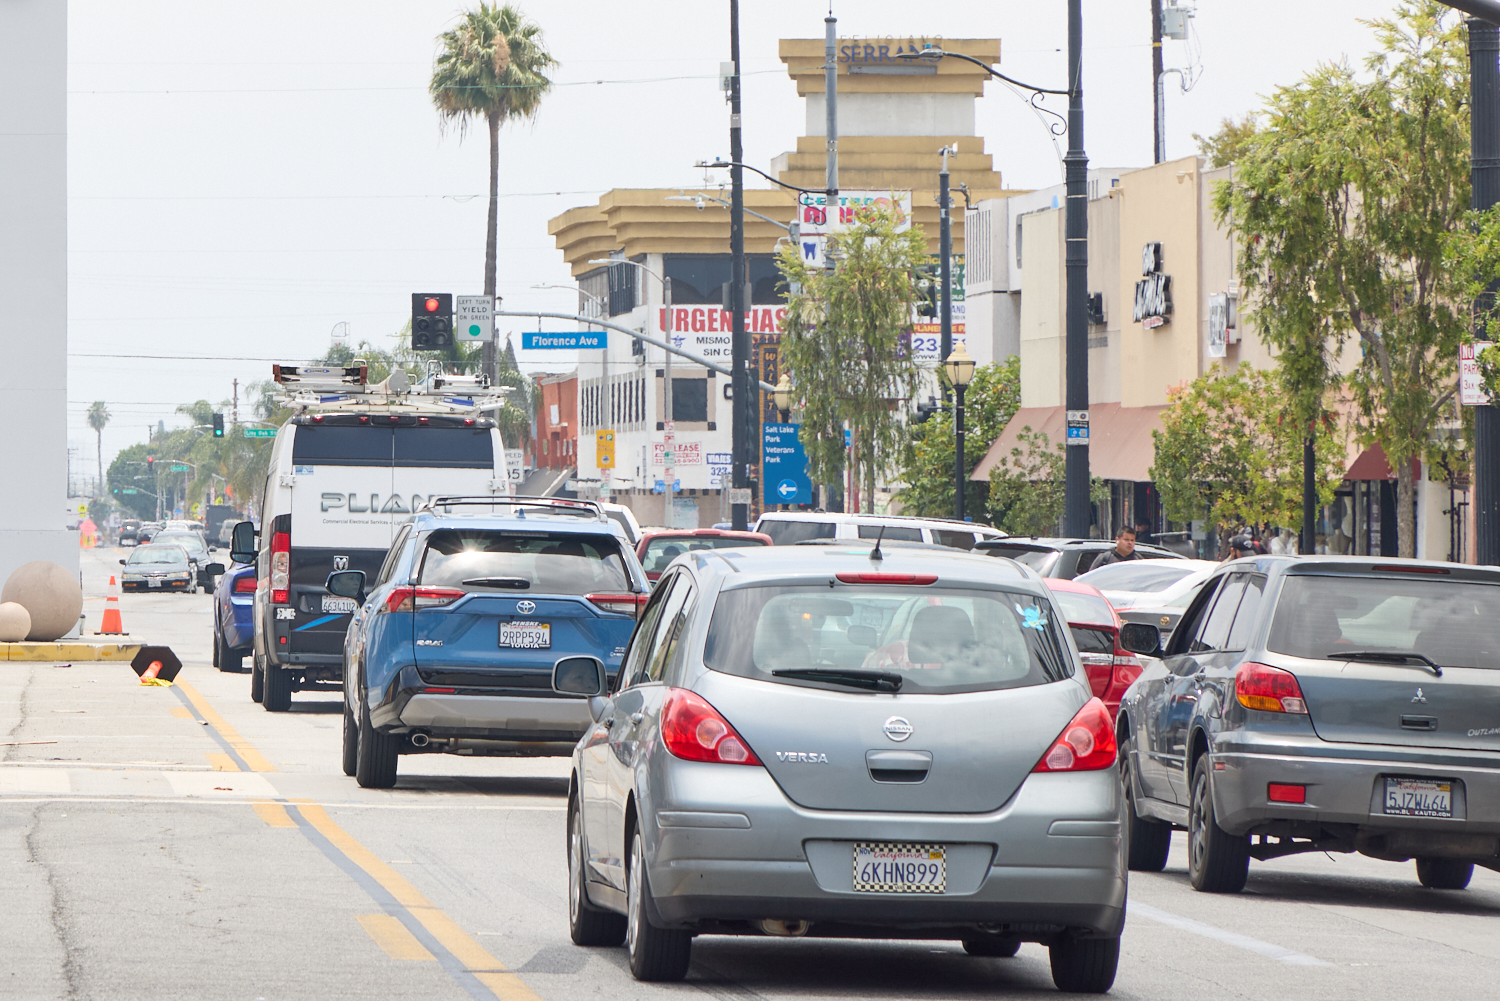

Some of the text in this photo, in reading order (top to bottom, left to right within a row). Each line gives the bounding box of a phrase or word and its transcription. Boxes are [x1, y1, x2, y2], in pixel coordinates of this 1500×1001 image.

[532, 336, 599, 347] Florence Ave
[696, 336, 730, 345] MISMO
[703, 348, 721, 356] SIN
[1463, 364, 1480, 375] PARK
[765, 352, 776, 410] WALUT
[765, 435, 781, 443] Park
[654, 444, 700, 452] FO LEASE
[765, 446, 795, 454] Veterans
[502, 630, 548, 644] 9RPP594
[1467, 727, 1500, 737] OUTLAN
[776, 751, 829, 764] VERSA
[1389, 791, 1448, 811] 5JZW464
[873, 849, 924, 861] California
[860, 862, 939, 884] 6KHN899
